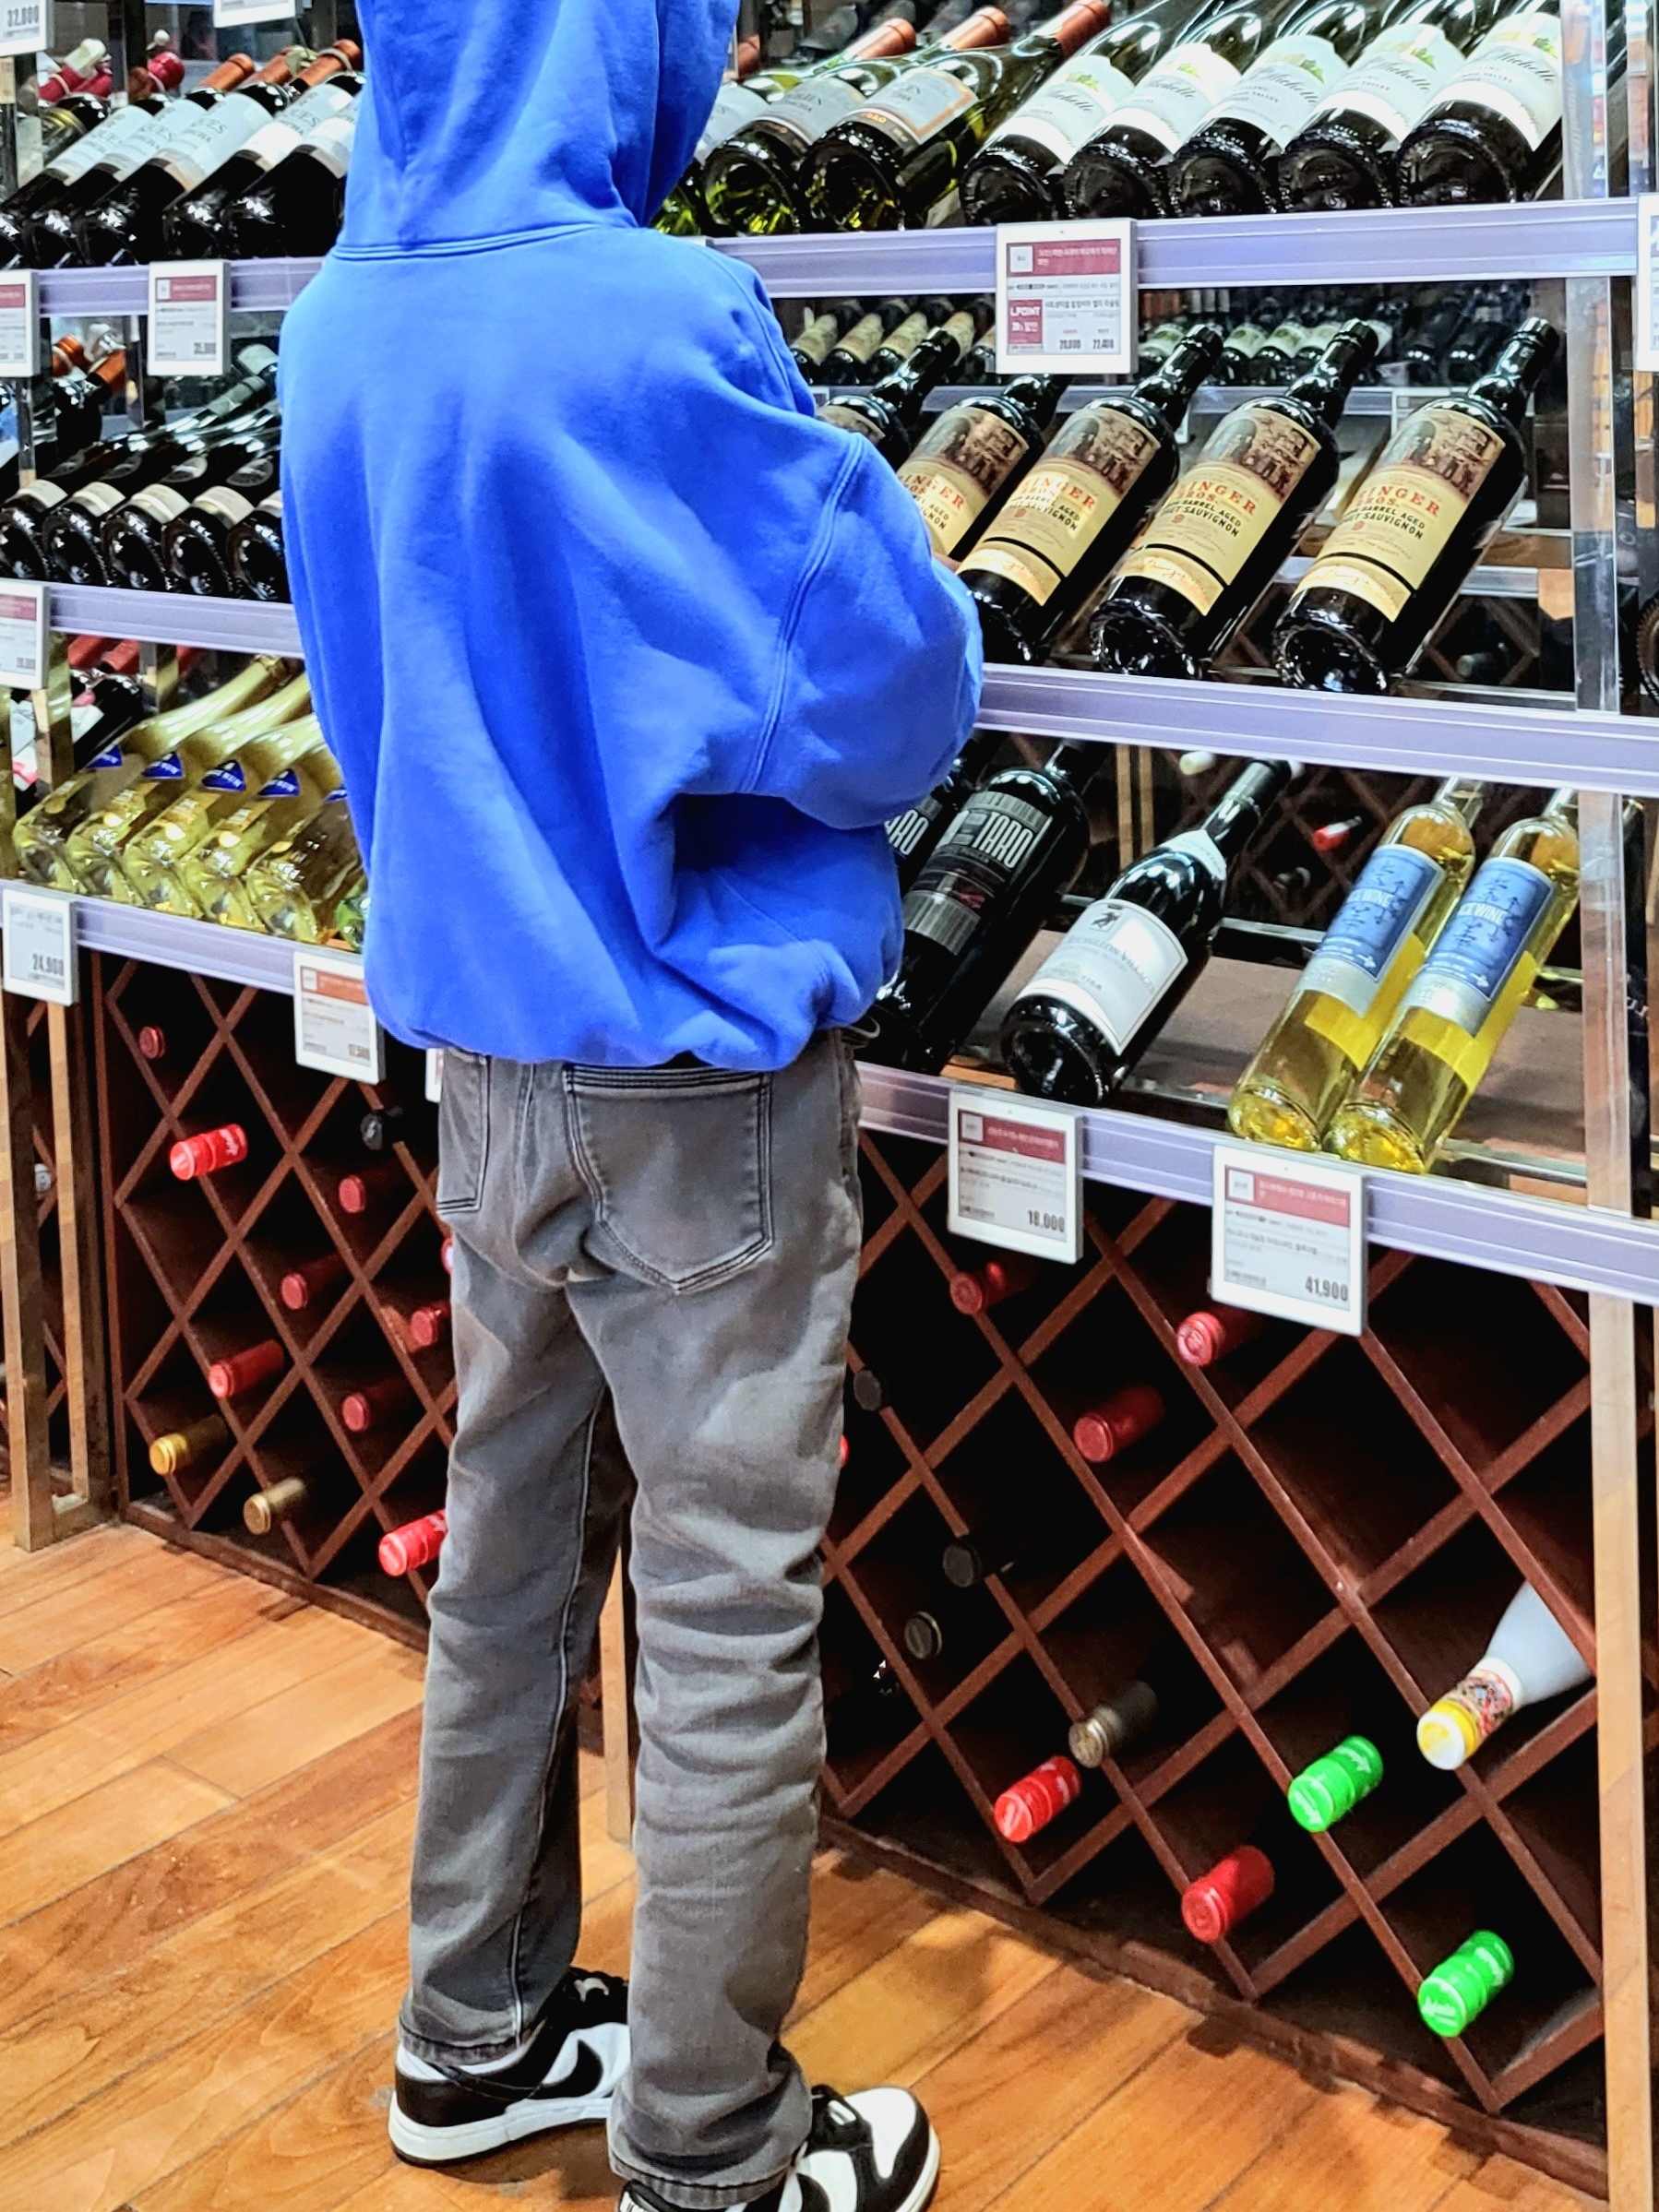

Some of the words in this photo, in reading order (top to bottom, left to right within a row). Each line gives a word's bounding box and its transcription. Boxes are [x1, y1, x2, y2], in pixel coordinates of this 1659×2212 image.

[1027, 502, 1078, 531] SAUVIGNON
[1057, 505, 1081, 521] AGED
[1182, 499, 1217, 512] BARREL
[1218, 509, 1243, 528] AGED
[1184, 505, 1240, 538] SAUVIGNON
[1364, 512, 1425, 541] SAUVIGNON
[1400, 512, 1426, 530] AGED
[1305, 1275, 1349, 1302] 41,900
